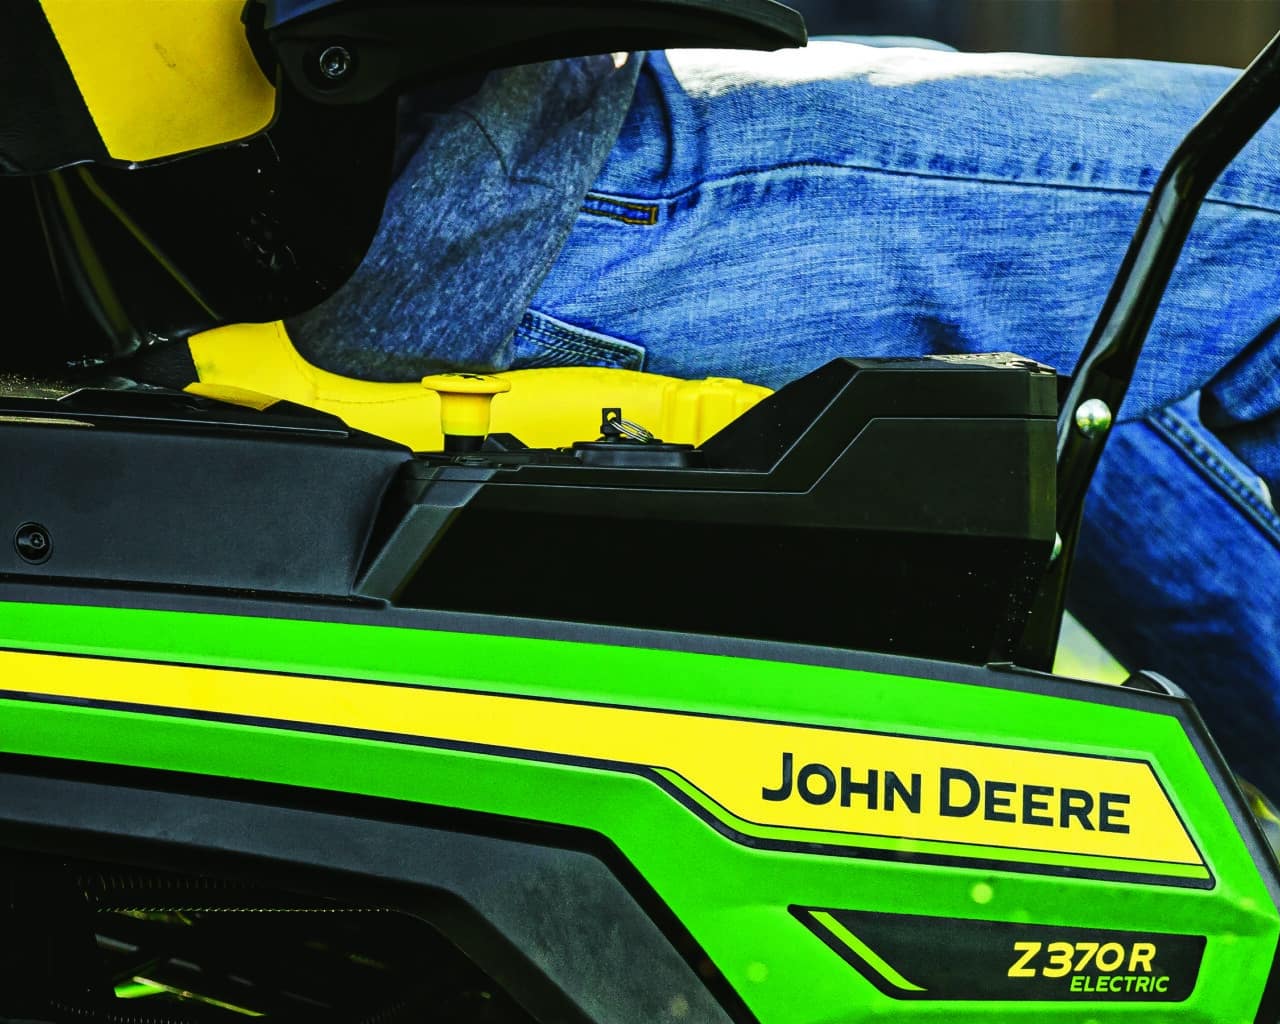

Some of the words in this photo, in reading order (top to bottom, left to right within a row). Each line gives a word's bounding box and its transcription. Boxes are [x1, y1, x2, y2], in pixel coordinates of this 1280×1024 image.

[762, 752, 922, 815] JOHN
[939, 767, 1131, 835] DEERE
[1070, 976, 1171, 993] ELECTRIC
